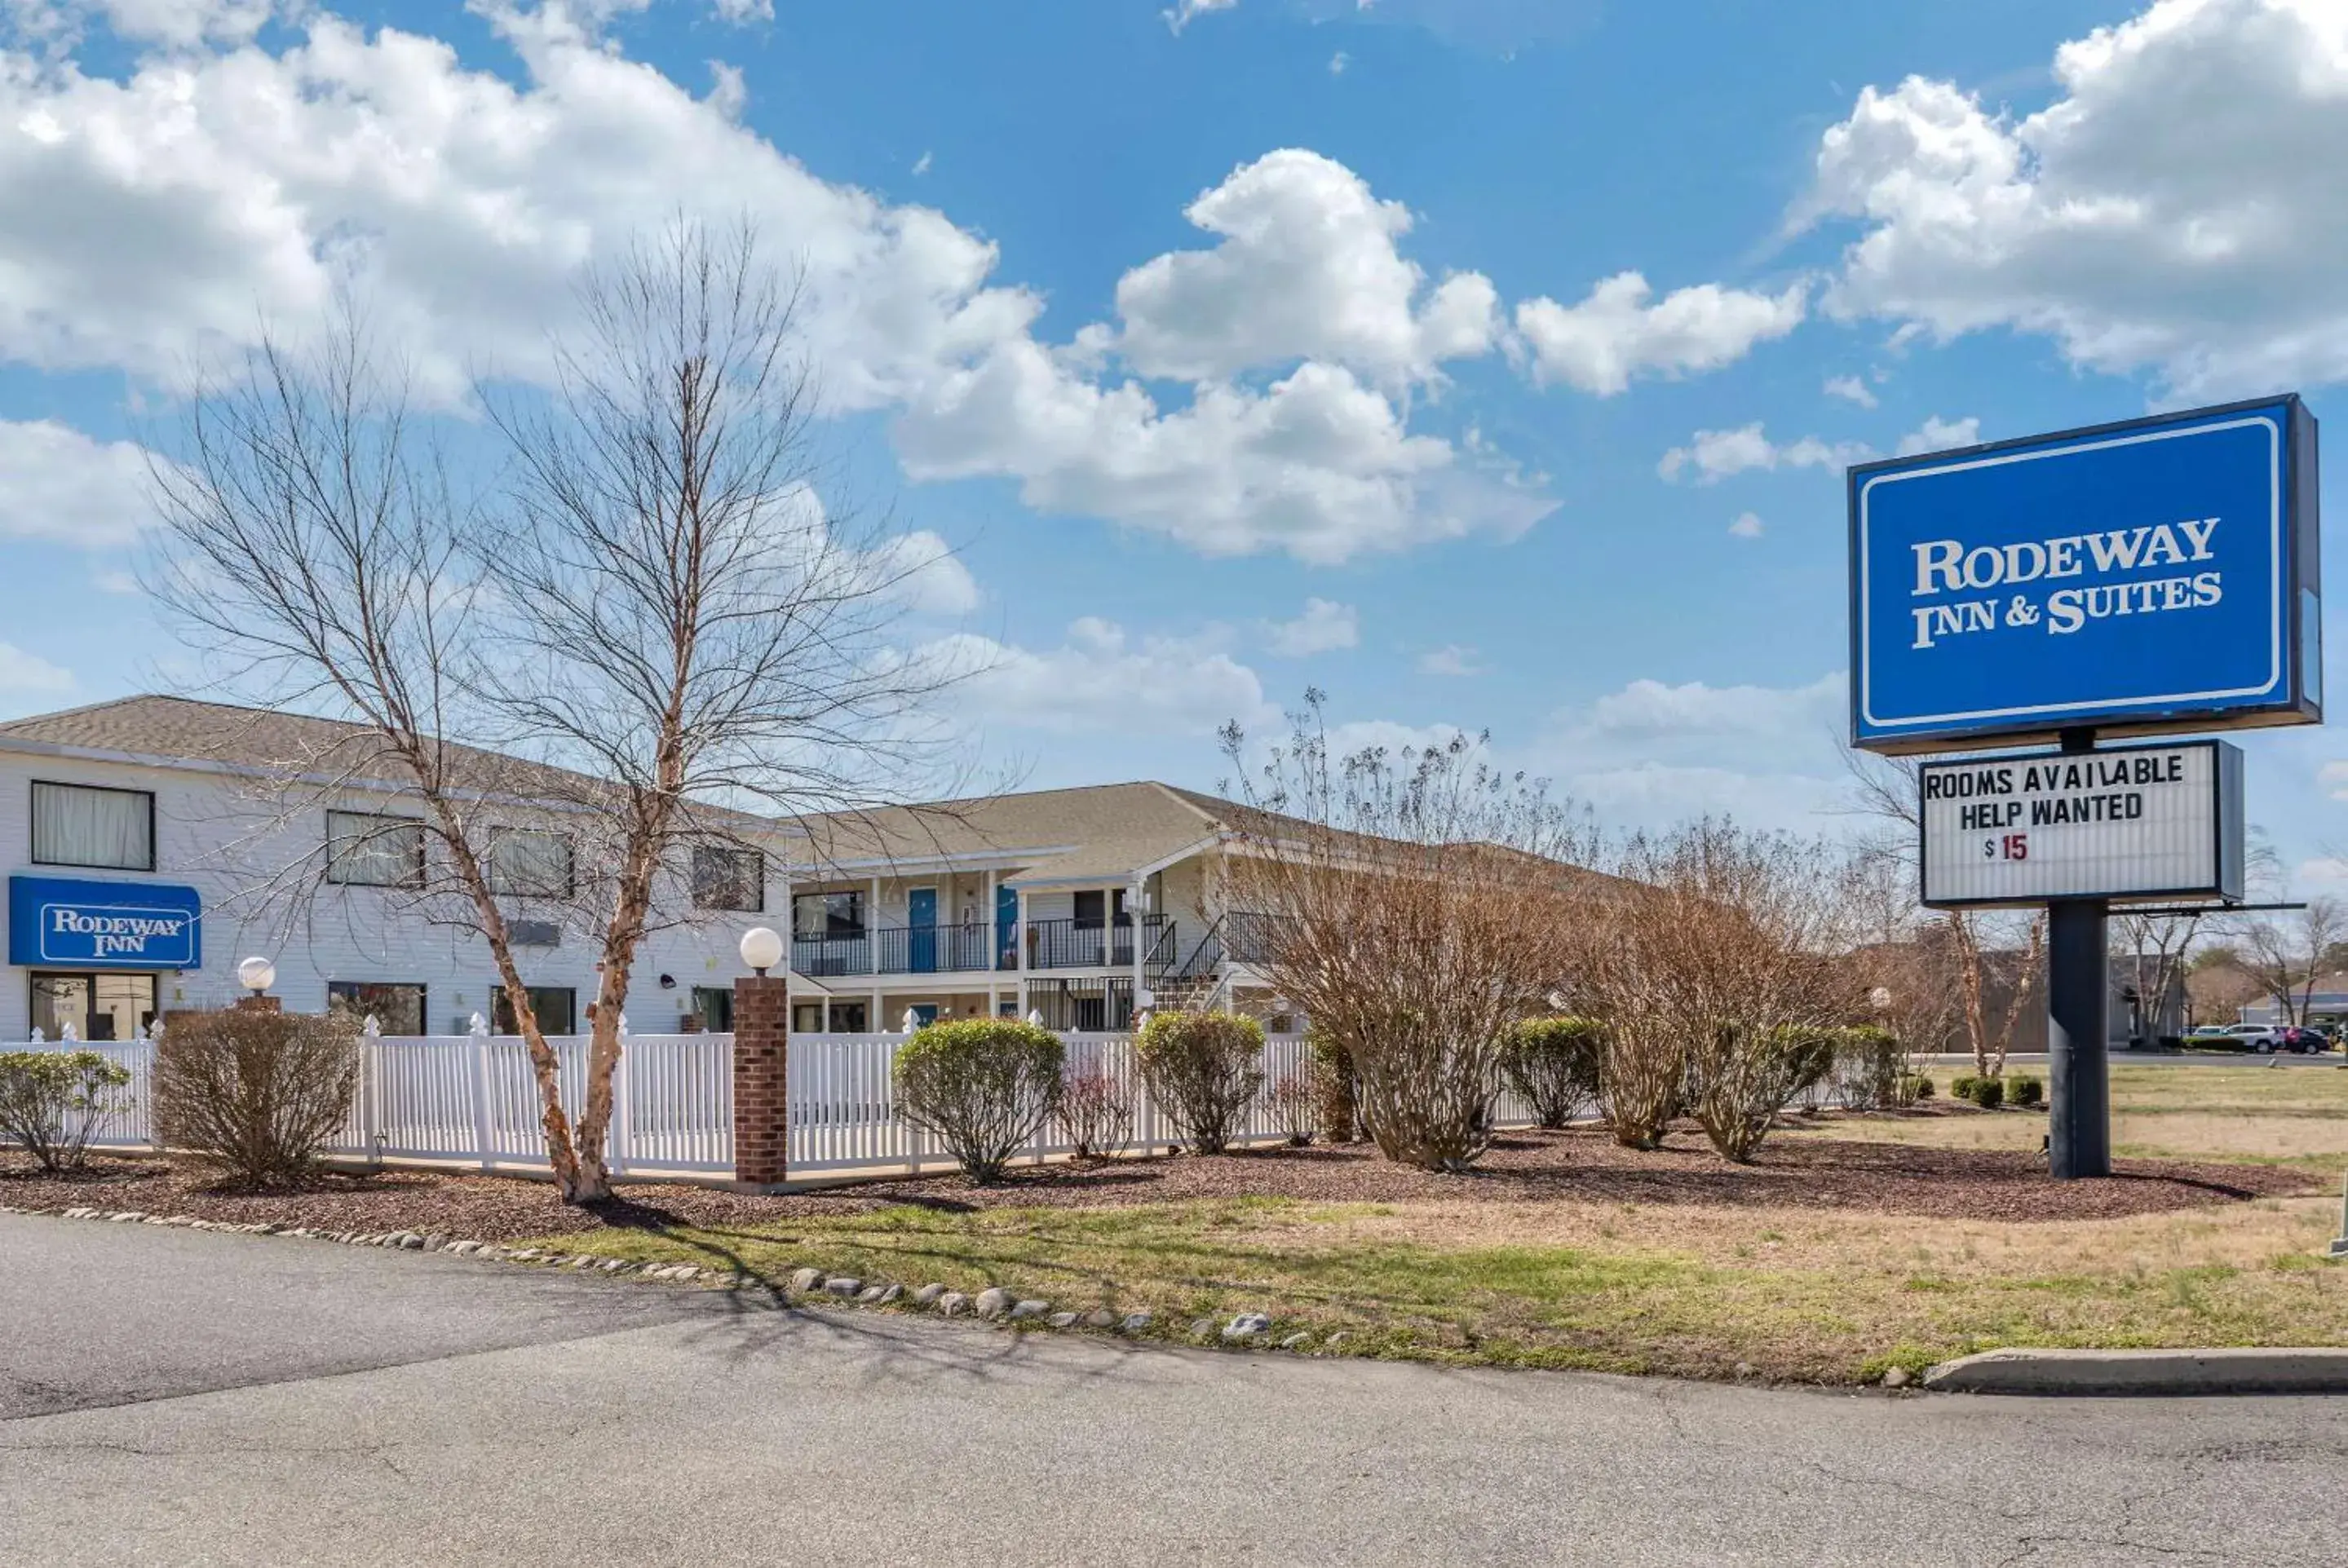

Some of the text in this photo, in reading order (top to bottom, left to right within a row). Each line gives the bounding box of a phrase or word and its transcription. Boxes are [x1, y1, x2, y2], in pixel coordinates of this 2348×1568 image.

[1911, 518, 2221, 596] RODEWAY
[1912, 572, 2222, 649] INN & SUITES
[1926, 755, 2182, 799] ROOMS AVAILABLE
[1961, 793, 2142, 830] HELP WANTED
[2002, 834, 2027, 860] 15
[53, 909, 181, 937] RODEWAY
[93, 936, 145, 957] INN
